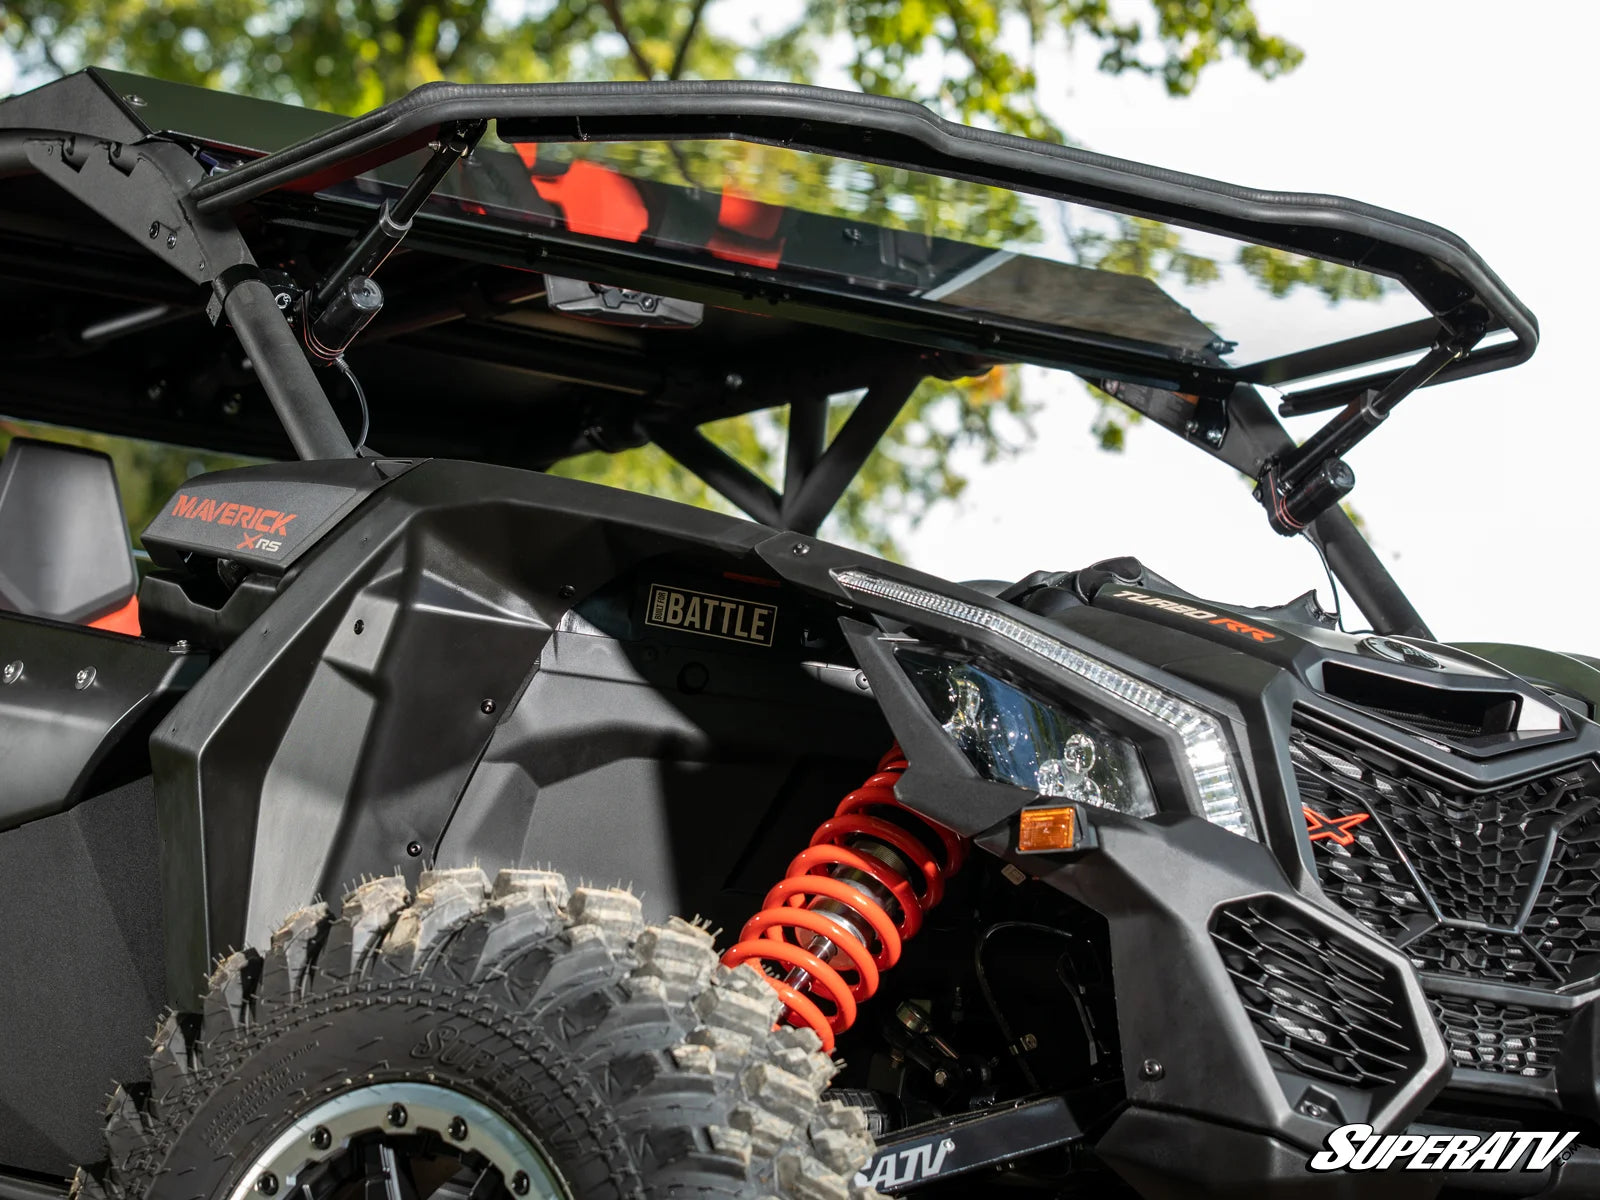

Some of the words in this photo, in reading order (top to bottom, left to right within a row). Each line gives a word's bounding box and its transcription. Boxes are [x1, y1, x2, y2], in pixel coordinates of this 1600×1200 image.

[171, 494, 297, 536] MAVERICK
[666, 592, 769, 641] BATTLE
[1113, 590, 1218, 620] TURBO
[1208, 617, 1276, 643] RR
